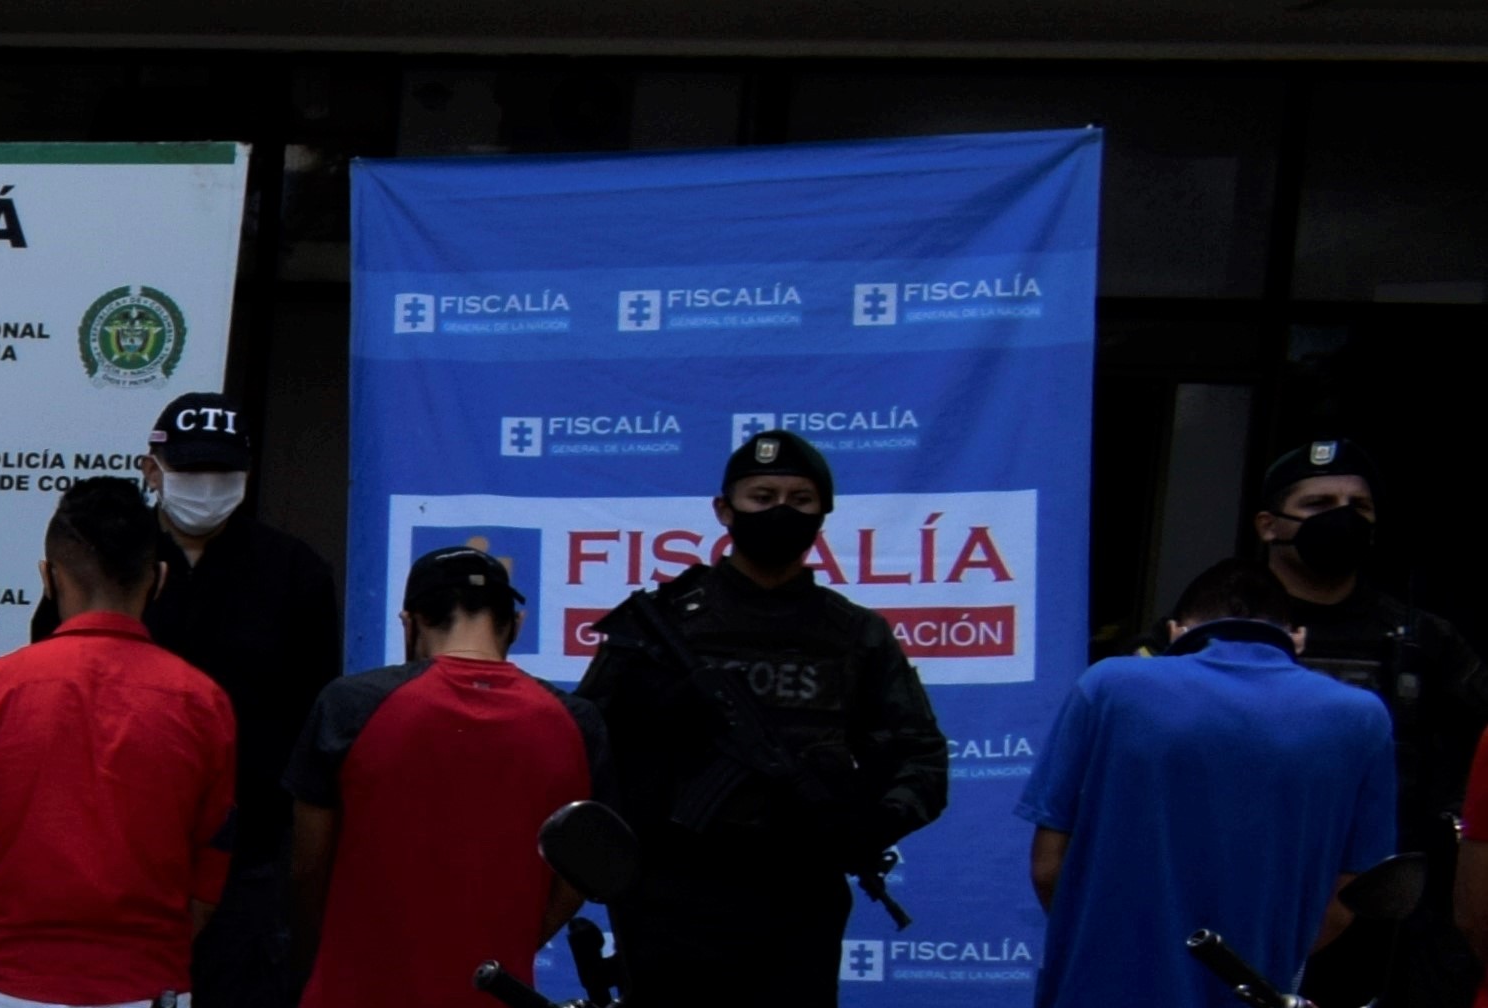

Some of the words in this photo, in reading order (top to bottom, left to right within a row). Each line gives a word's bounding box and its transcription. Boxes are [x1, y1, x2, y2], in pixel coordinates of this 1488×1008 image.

[667, 283, 802, 308] FISCALÍA
[904, 272, 1042, 302] FISCALÍA
[441, 290, 570, 315] FISCALÍA
[176, 406, 238, 434] CTI
[548, 411, 681, 436] FISCALÍA
[781, 405, 919, 431] FISCALÍA
[74, 453, 144, 470] NACI
[0, 475, 29, 491] DE
[893, 613, 1003, 646] ACIÓN
[748, 663, 820, 700] OES
[948, 733, 1033, 759] CALÍA
[891, 938, 1032, 961] FISCALÍA
